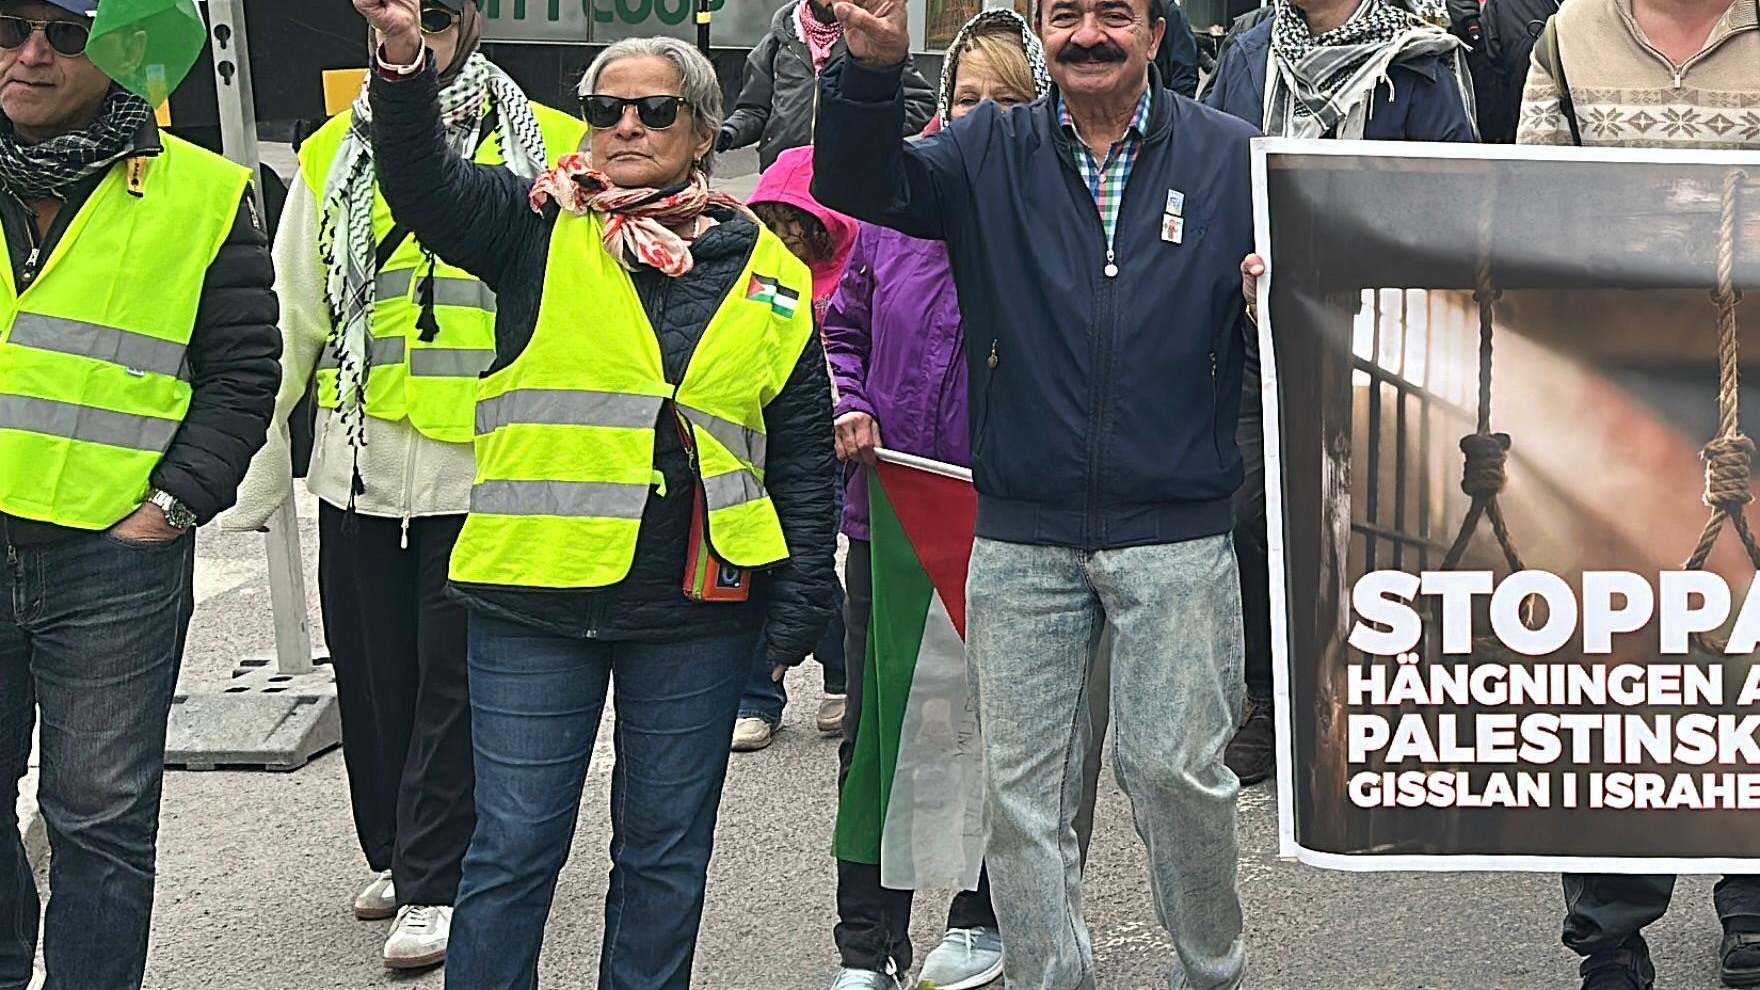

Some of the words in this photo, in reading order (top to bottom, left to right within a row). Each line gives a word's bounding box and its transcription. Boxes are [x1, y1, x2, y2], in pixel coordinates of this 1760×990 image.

[1347, 653, 1723, 706] HÄNGNINGEN
[1347, 773, 1551, 809] GISSLAN
[1563, 773, 1578, 808] I
